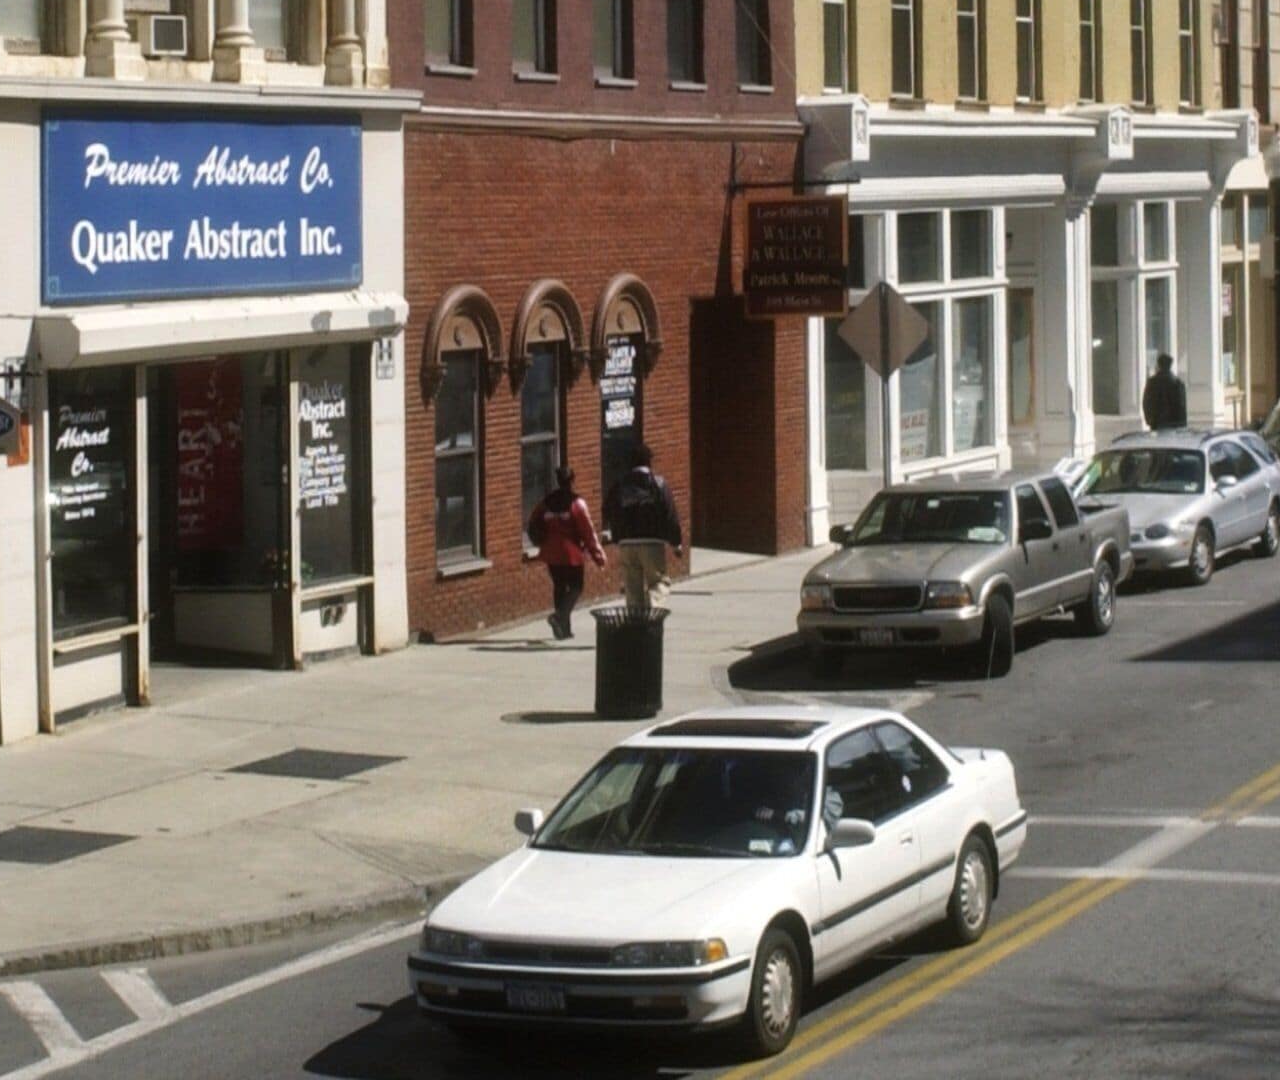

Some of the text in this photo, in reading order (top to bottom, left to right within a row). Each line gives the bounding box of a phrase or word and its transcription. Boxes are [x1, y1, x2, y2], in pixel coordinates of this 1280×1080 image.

[84, 143, 334, 194] Premier Abstract Co.
[71, 216, 343, 274] Quaker Abstract Inc.
[59, 405, 107, 426] Premier
[299, 400, 346, 420] Abstract
[56, 427, 110, 451] Abstract
[311, 420, 333, 439] Inc.
[70, 451, 94, 477] Co.
